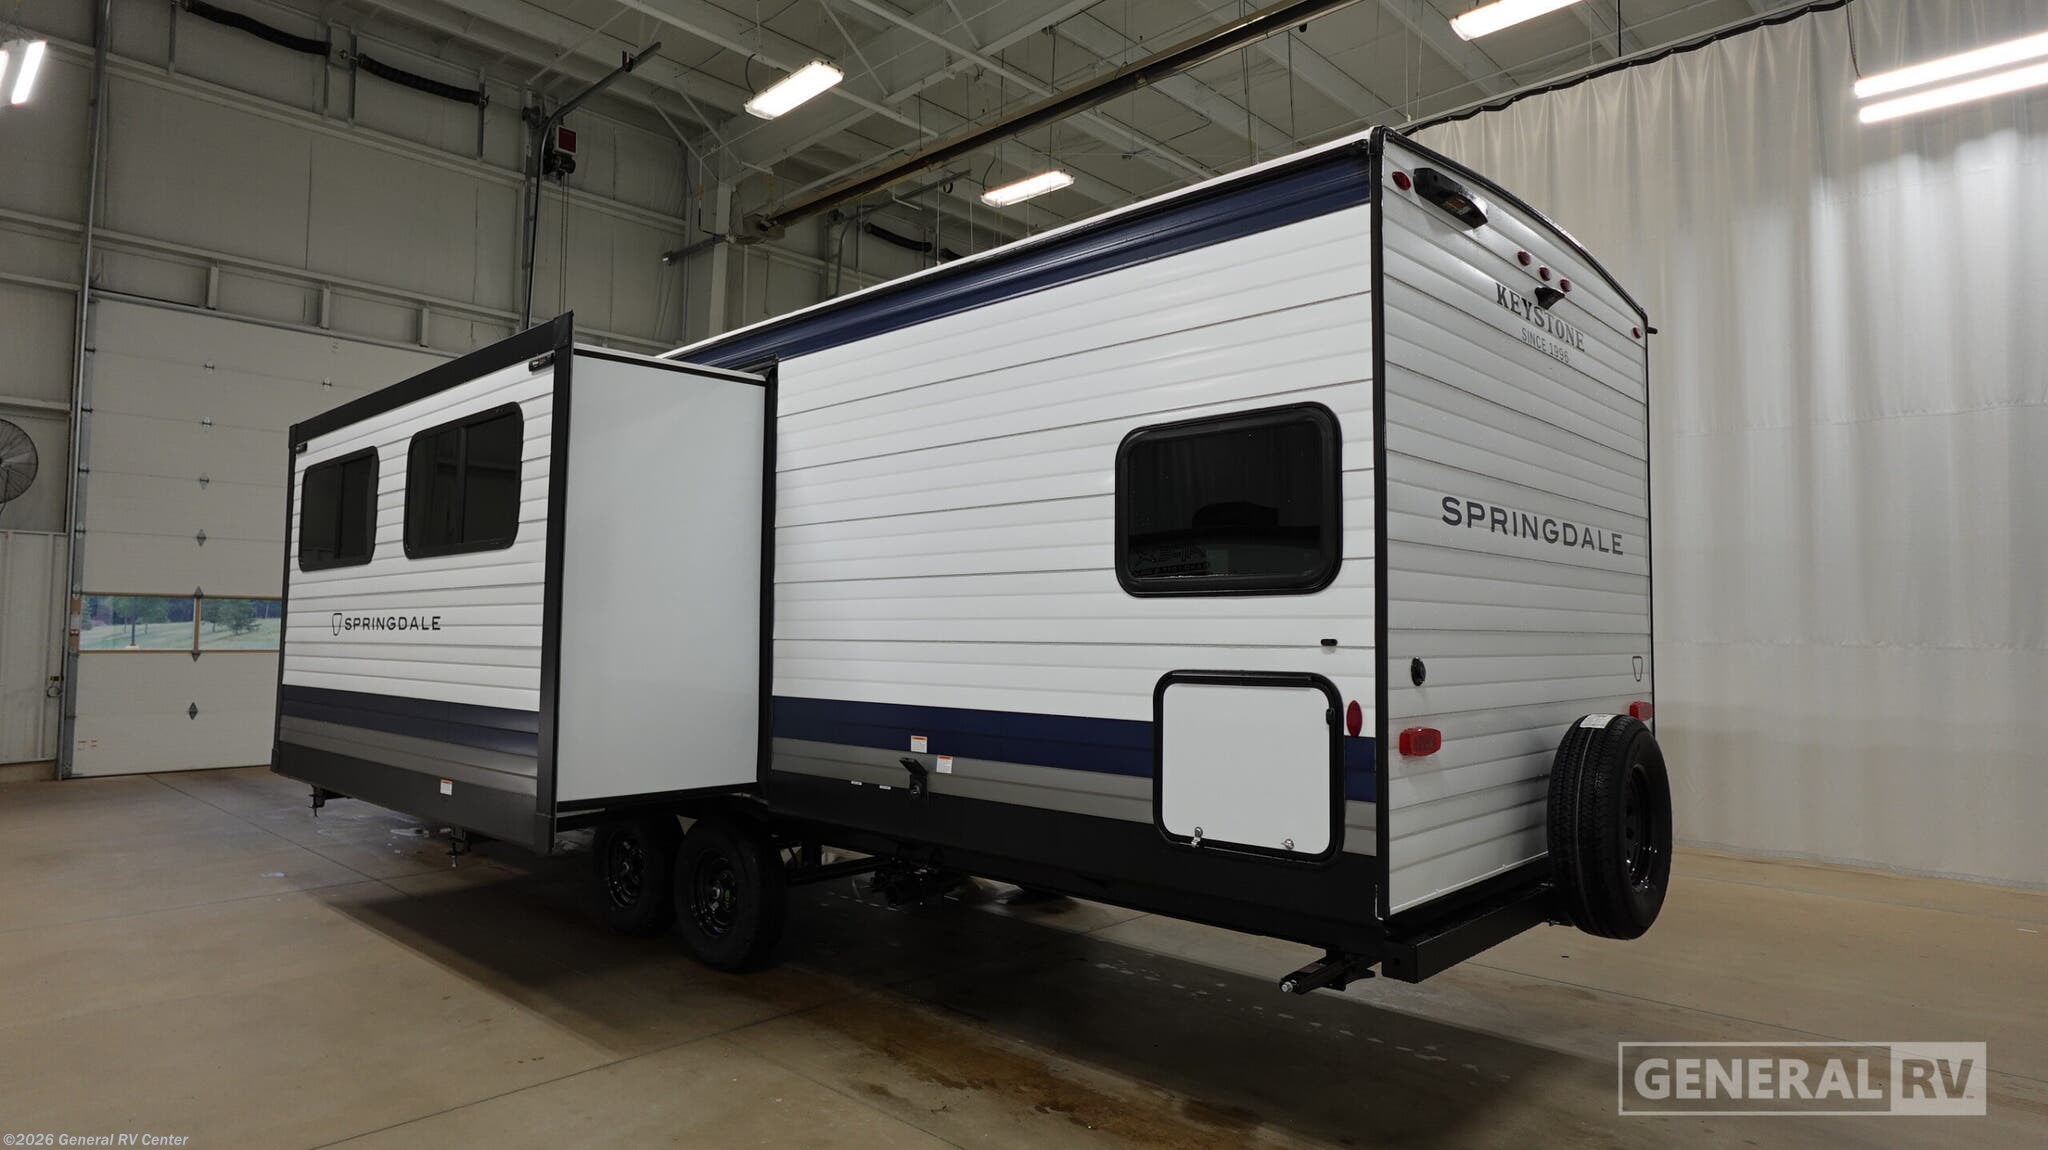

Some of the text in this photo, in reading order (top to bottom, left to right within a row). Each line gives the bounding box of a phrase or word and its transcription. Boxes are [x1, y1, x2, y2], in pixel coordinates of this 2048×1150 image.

[1496, 283, 1585, 352] KEYSTONE
[1521, 327, 1569, 364] SINCE 1996
[1441, 496, 1624, 556] SPRINGDALE
[344, 616, 441, 631] SPRINGDALE
